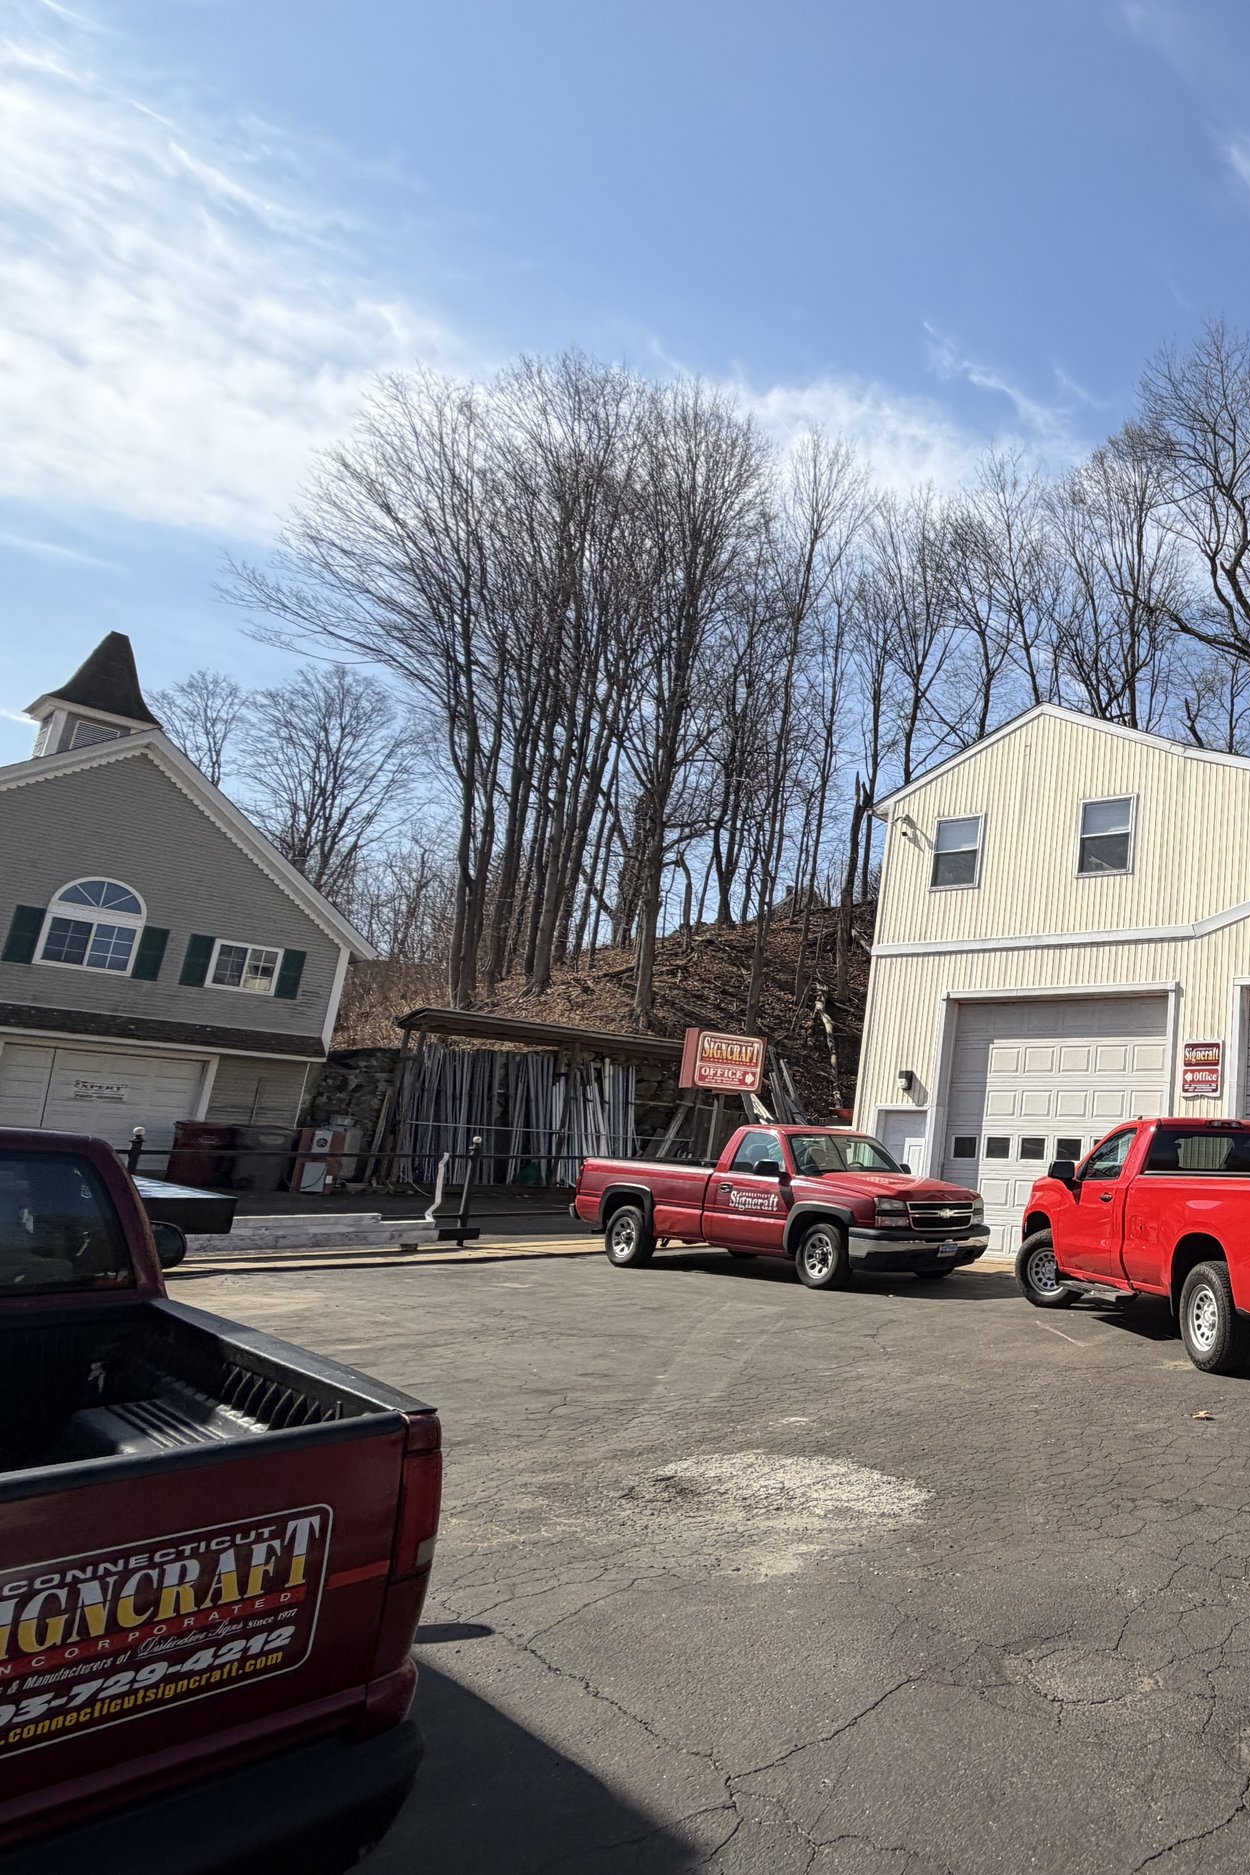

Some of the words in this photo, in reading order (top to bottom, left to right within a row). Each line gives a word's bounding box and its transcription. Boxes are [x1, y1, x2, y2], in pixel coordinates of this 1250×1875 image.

[703, 1036, 760, 1063] SIGNCRAFT
[1185, 1047, 1219, 1064] Signcraft
[701, 1067, 743, 1079] OFFICE
[1193, 1071, 1217, 1081] Office
[729, 1190, 778, 1211] Signcraft
[2, 1526, 276, 1597] CONNECTICUT
[7, 1680, 19, 1695] &
[23, 1657, 112, 1690] Manufacturers
[116, 1650, 131, 1665] of
[137, 1629, 206, 1657] Distinctive
[278, 1608, 298, 1620] 1977
